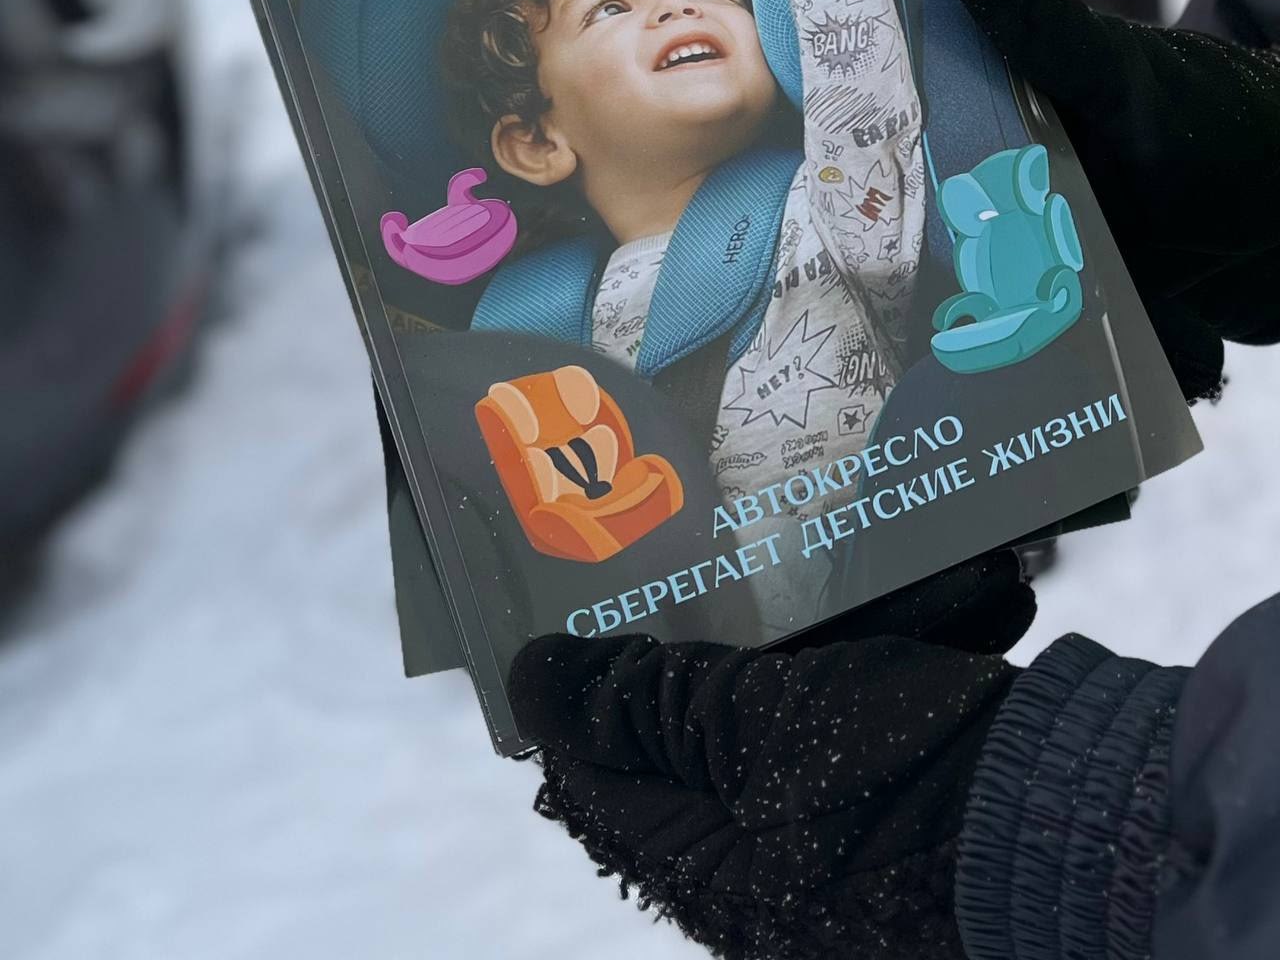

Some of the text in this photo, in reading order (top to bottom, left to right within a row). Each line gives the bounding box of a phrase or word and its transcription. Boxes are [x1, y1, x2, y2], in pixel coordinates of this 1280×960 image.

[722, 218, 752, 264] HERO
[756, 355, 805, 400] HEY?
[566, 393, 1127, 638] СБЕРЕГАЕТ ДЕТСКИЕ ЖИЗНИ
[713, 415, 964, 539] АВТОКРЕСЛО
